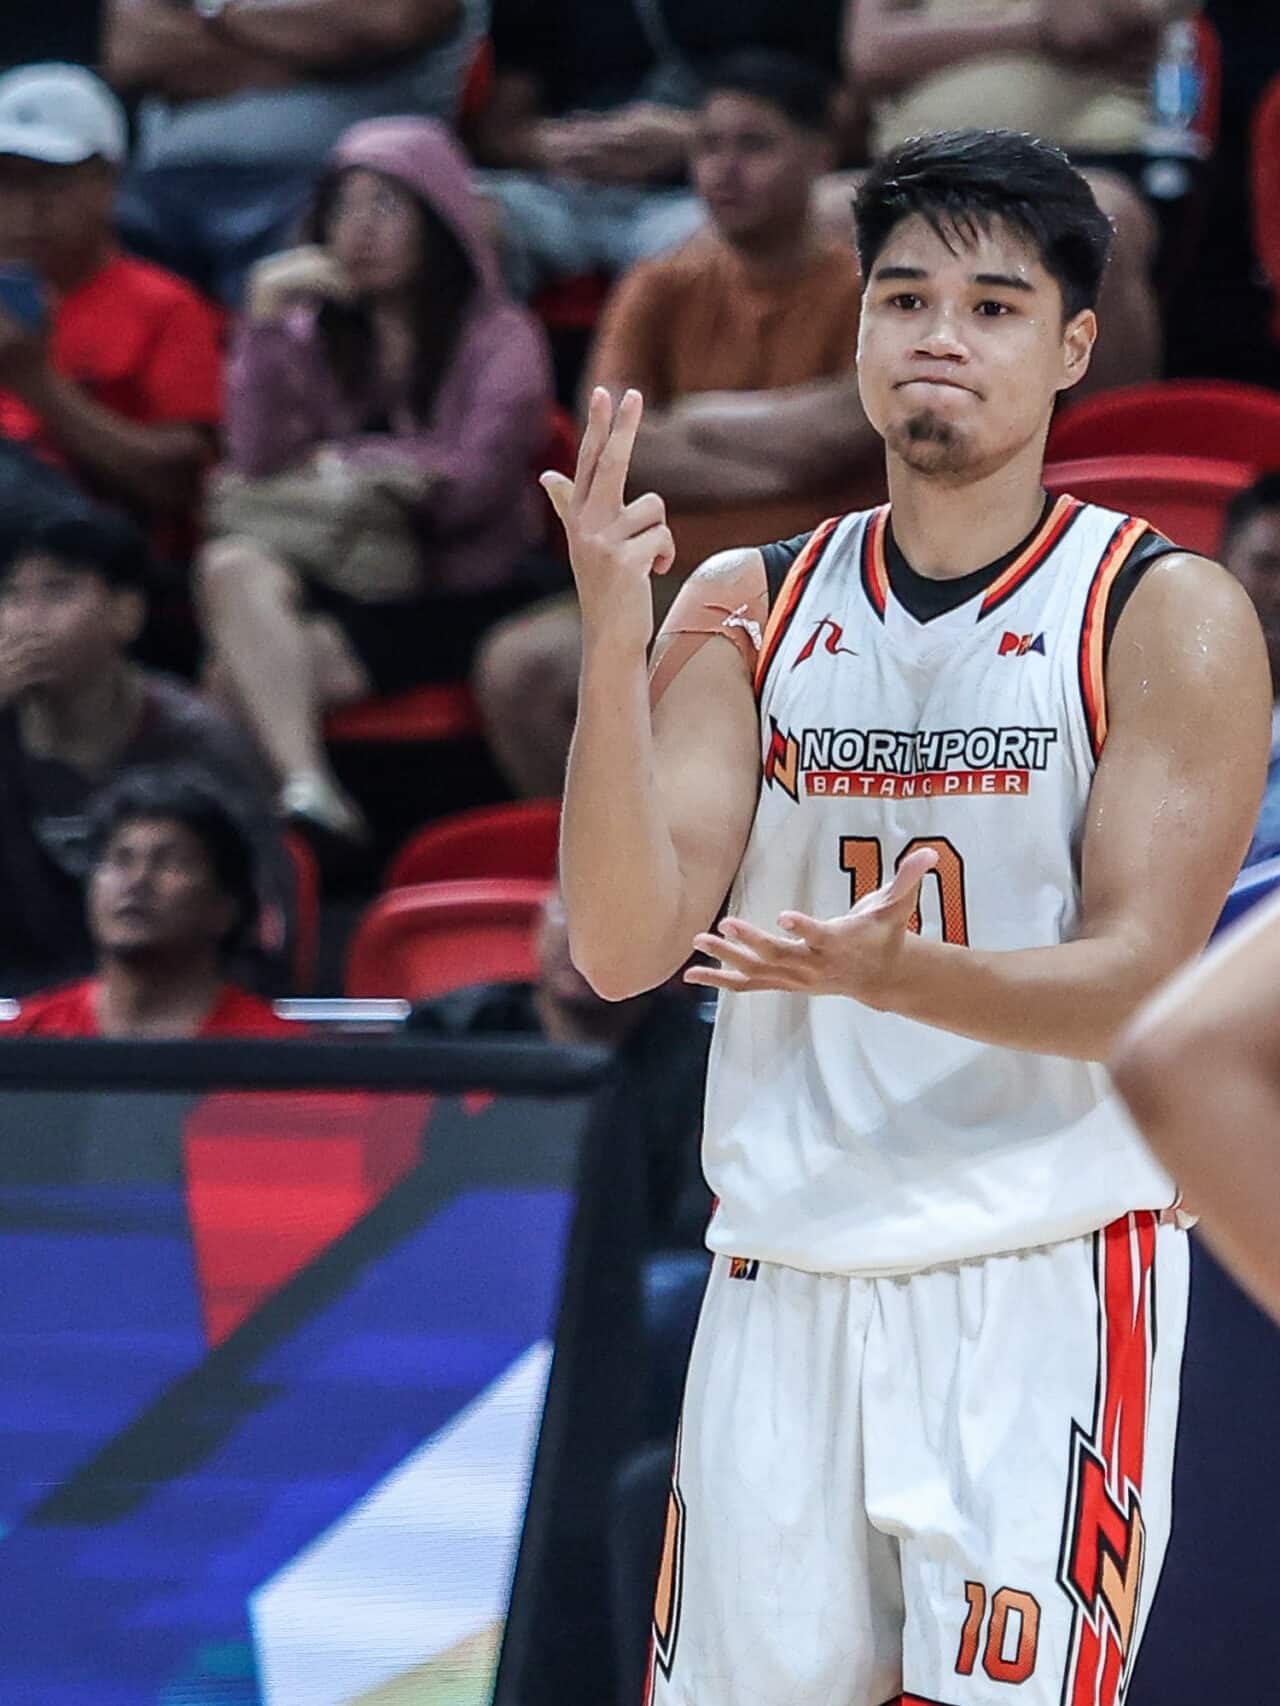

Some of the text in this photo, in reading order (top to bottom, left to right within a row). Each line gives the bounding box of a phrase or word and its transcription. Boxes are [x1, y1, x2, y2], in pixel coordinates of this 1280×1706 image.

[800, 726, 1057, 774] NORTHPORT
[812, 774, 1028, 797] BATANG PIER
[839, 836, 969, 948] 10
[954, 1580, 1041, 1685] 10
